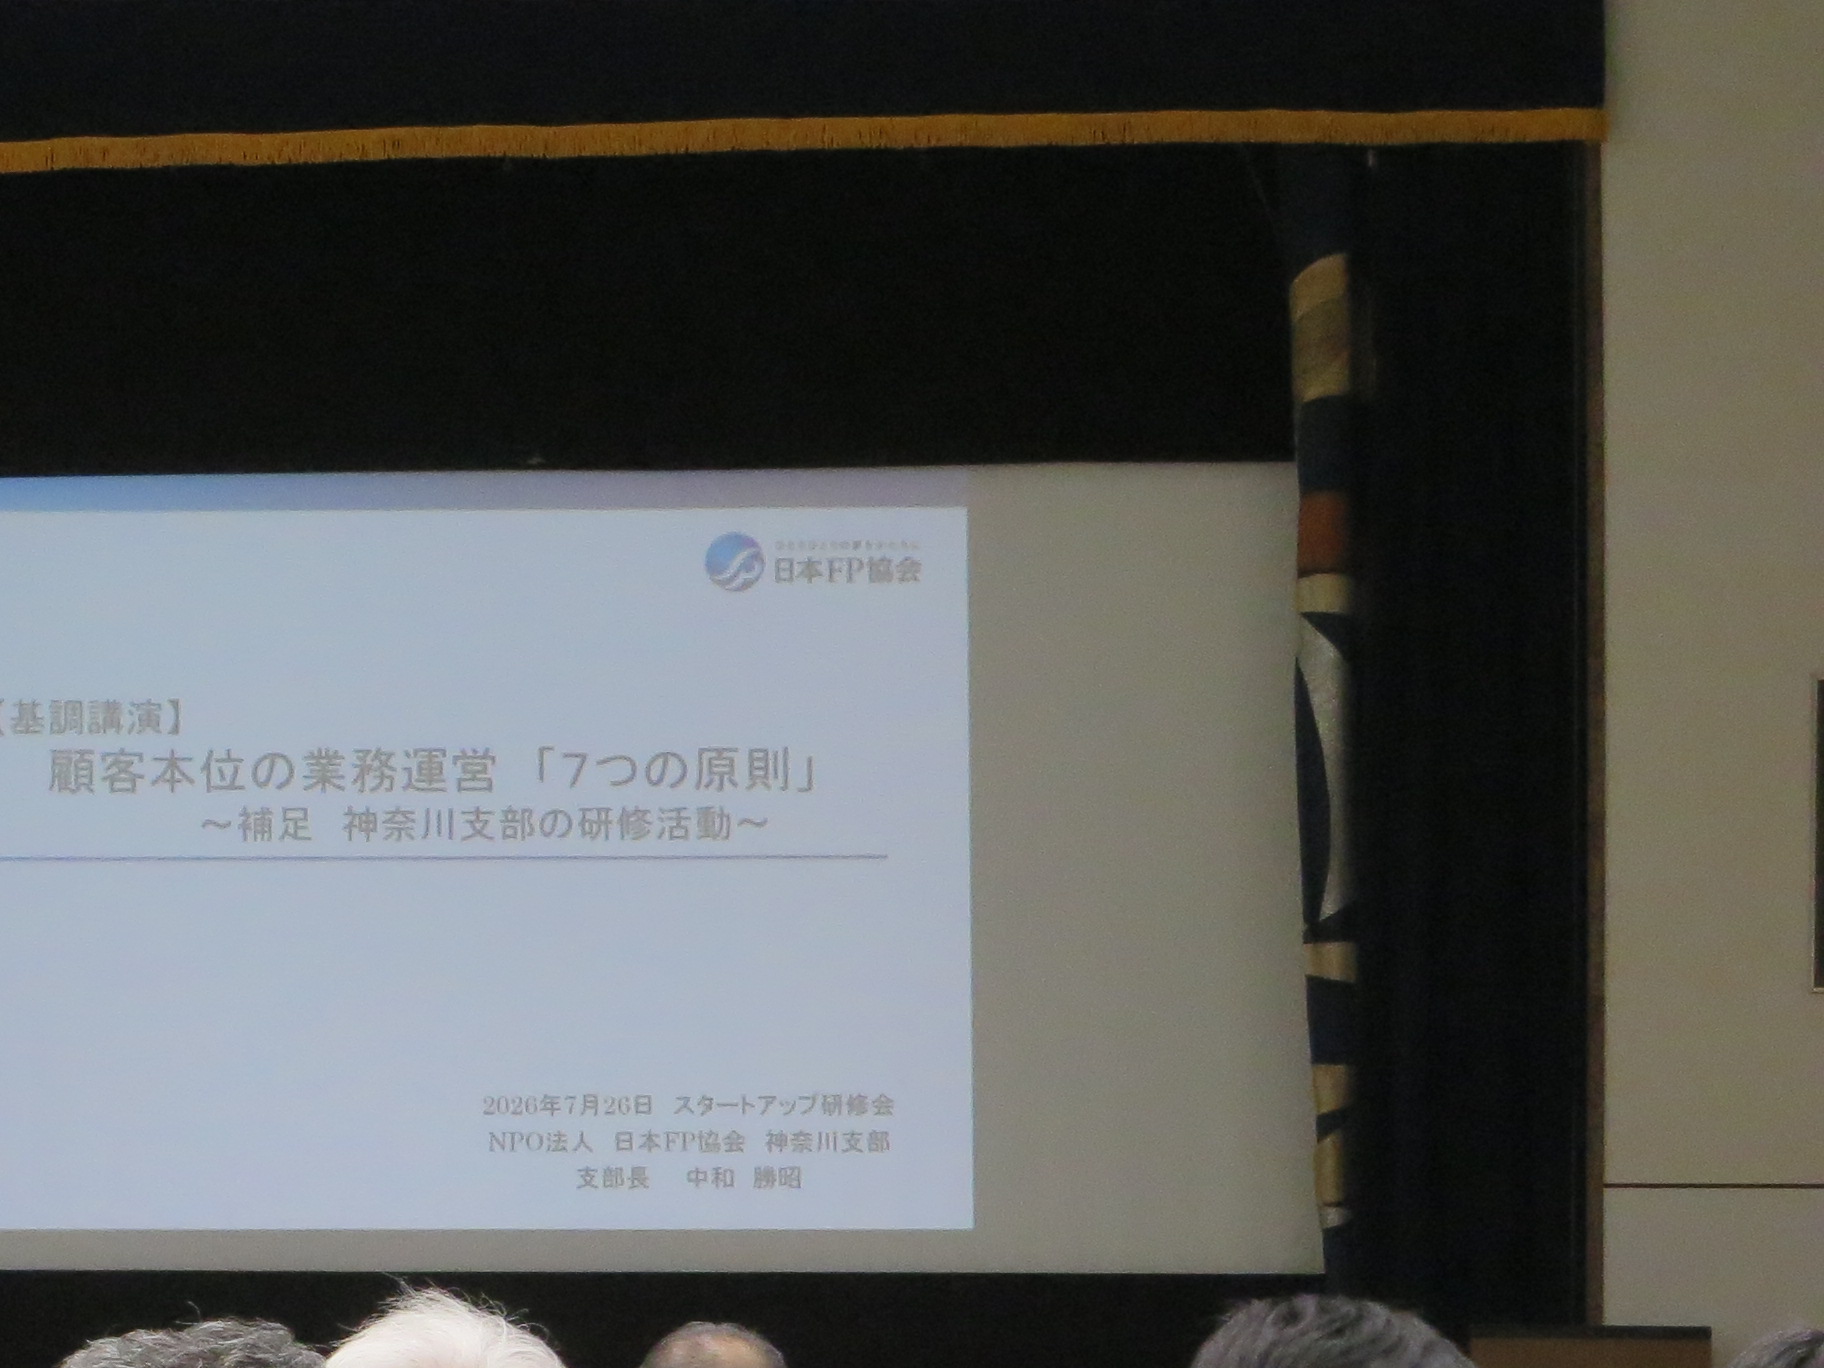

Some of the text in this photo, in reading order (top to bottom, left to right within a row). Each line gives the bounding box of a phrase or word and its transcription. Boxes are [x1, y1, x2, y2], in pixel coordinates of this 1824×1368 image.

[774, 555, 924, 584] 日本FP協会
[672, 1093, 895, 1117] スタートアップ研修会
[488, 1129, 891, 1154] NPO法人 日本FP協会 神奈川支部
[575, 1165, 650, 1190] 支部長
